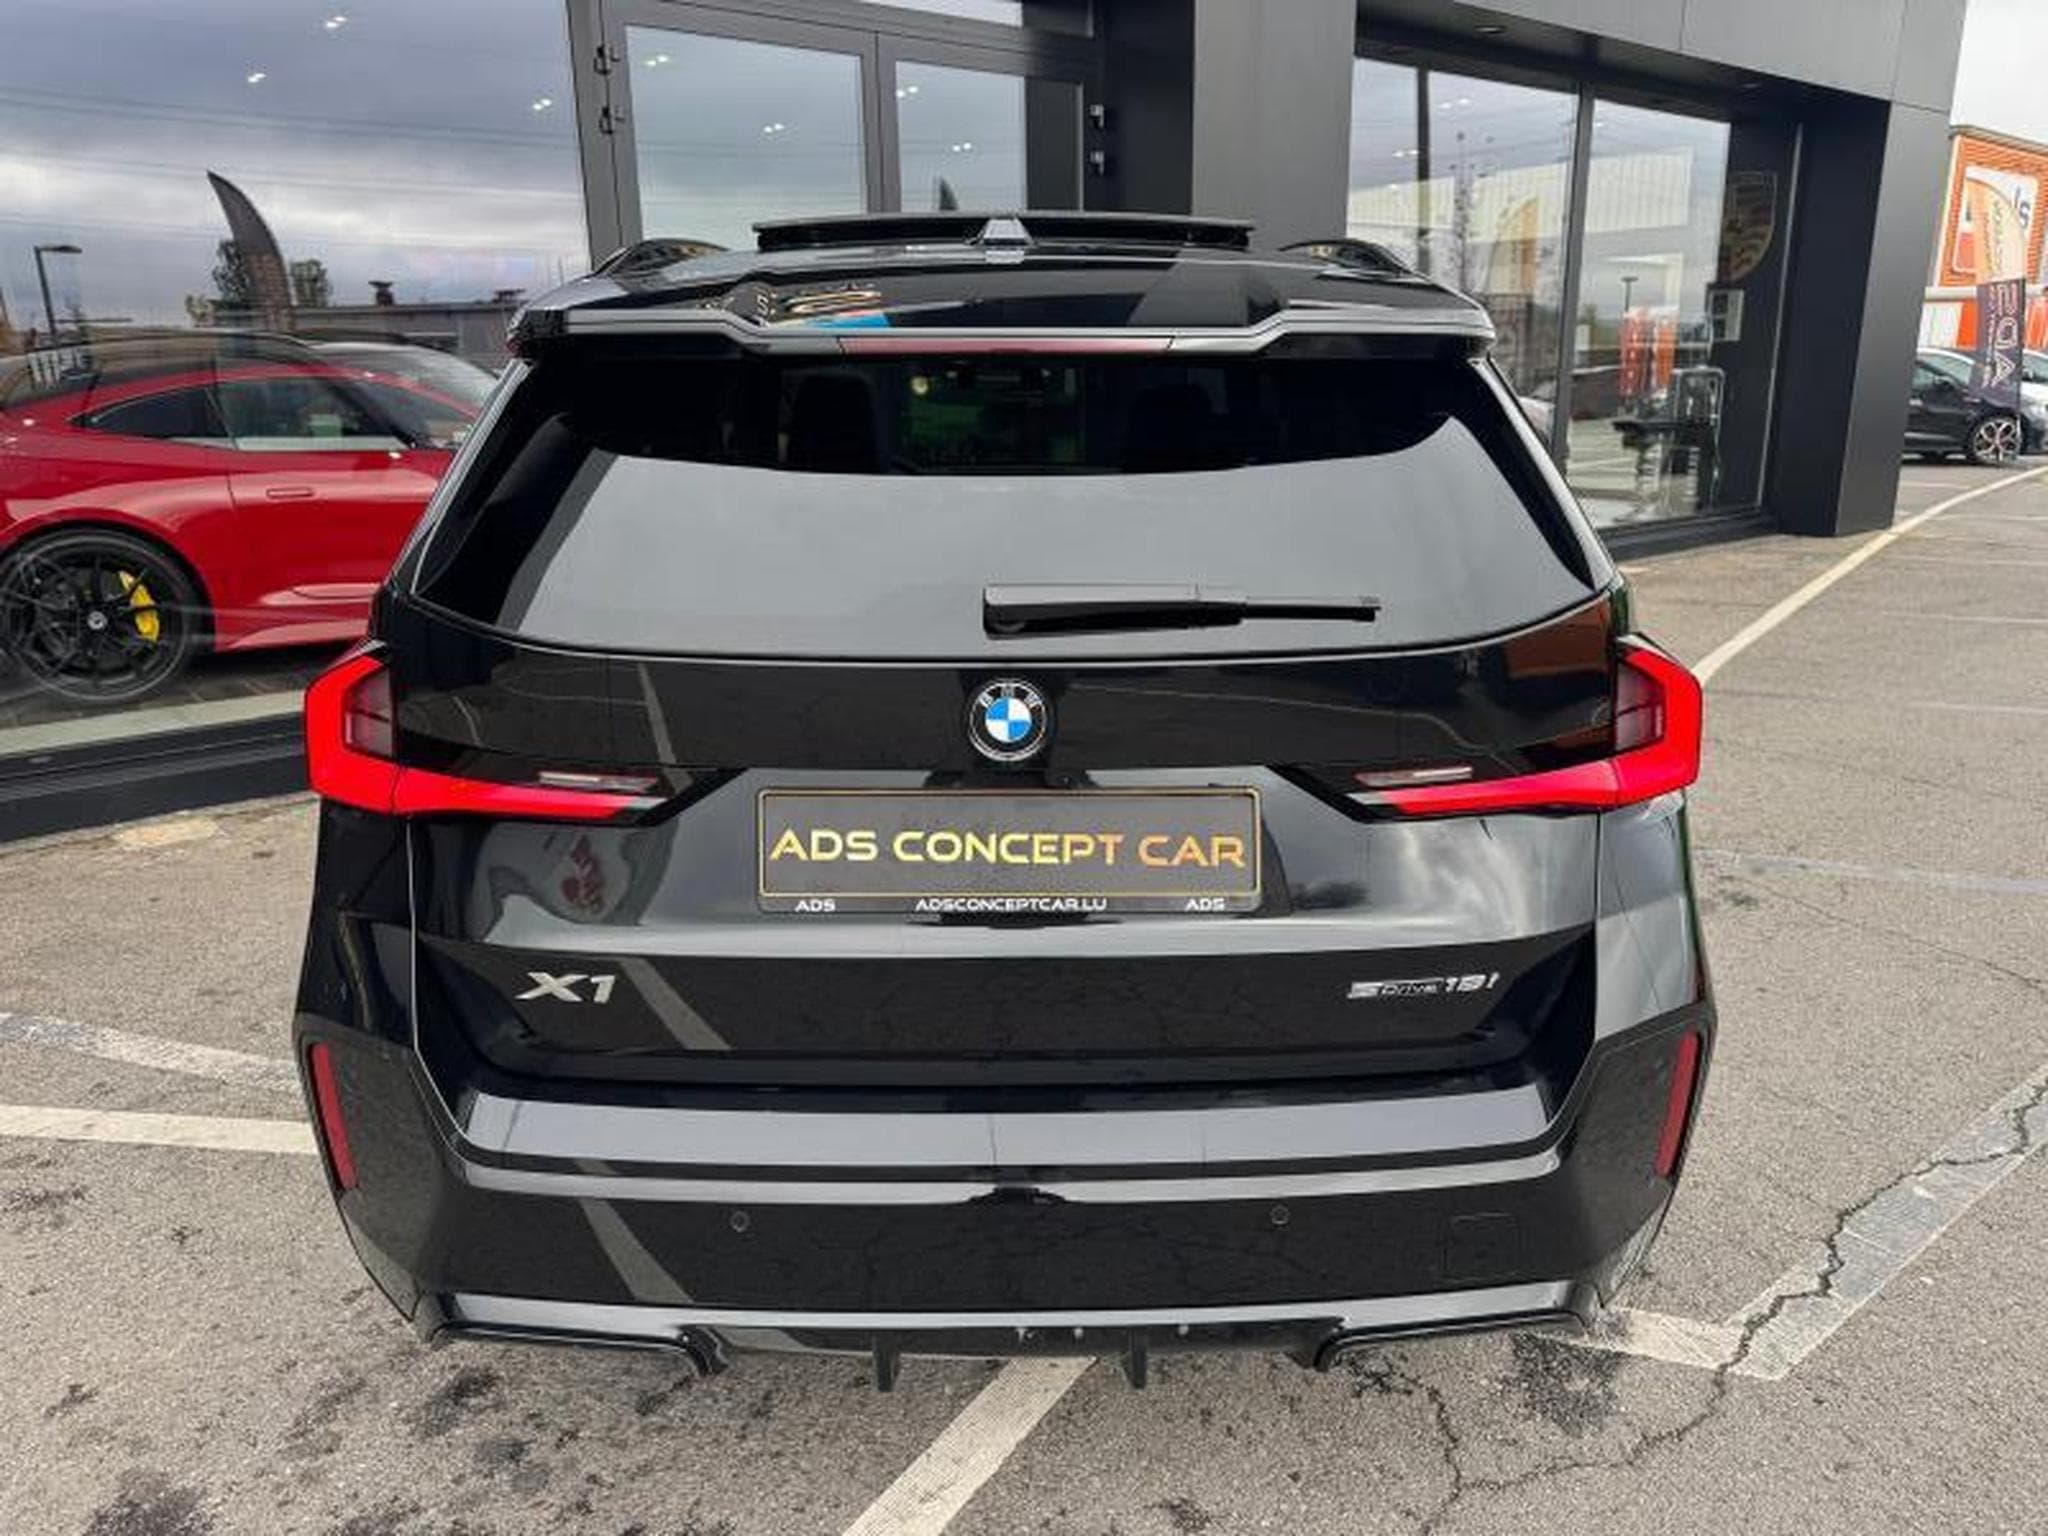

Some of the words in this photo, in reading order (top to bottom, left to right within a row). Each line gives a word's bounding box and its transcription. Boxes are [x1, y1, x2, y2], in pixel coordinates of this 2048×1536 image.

[769, 828, 879, 862] ADS
[892, 830, 1125, 866] CONCEPT
[1138, 834, 1246, 868] CAR
[795, 898, 836, 912] ADS
[916, 897, 1107, 912] ADSCONCEPTCAR.LU
[1185, 898, 1226, 912] ADS
[515, 971, 615, 1003] X1
